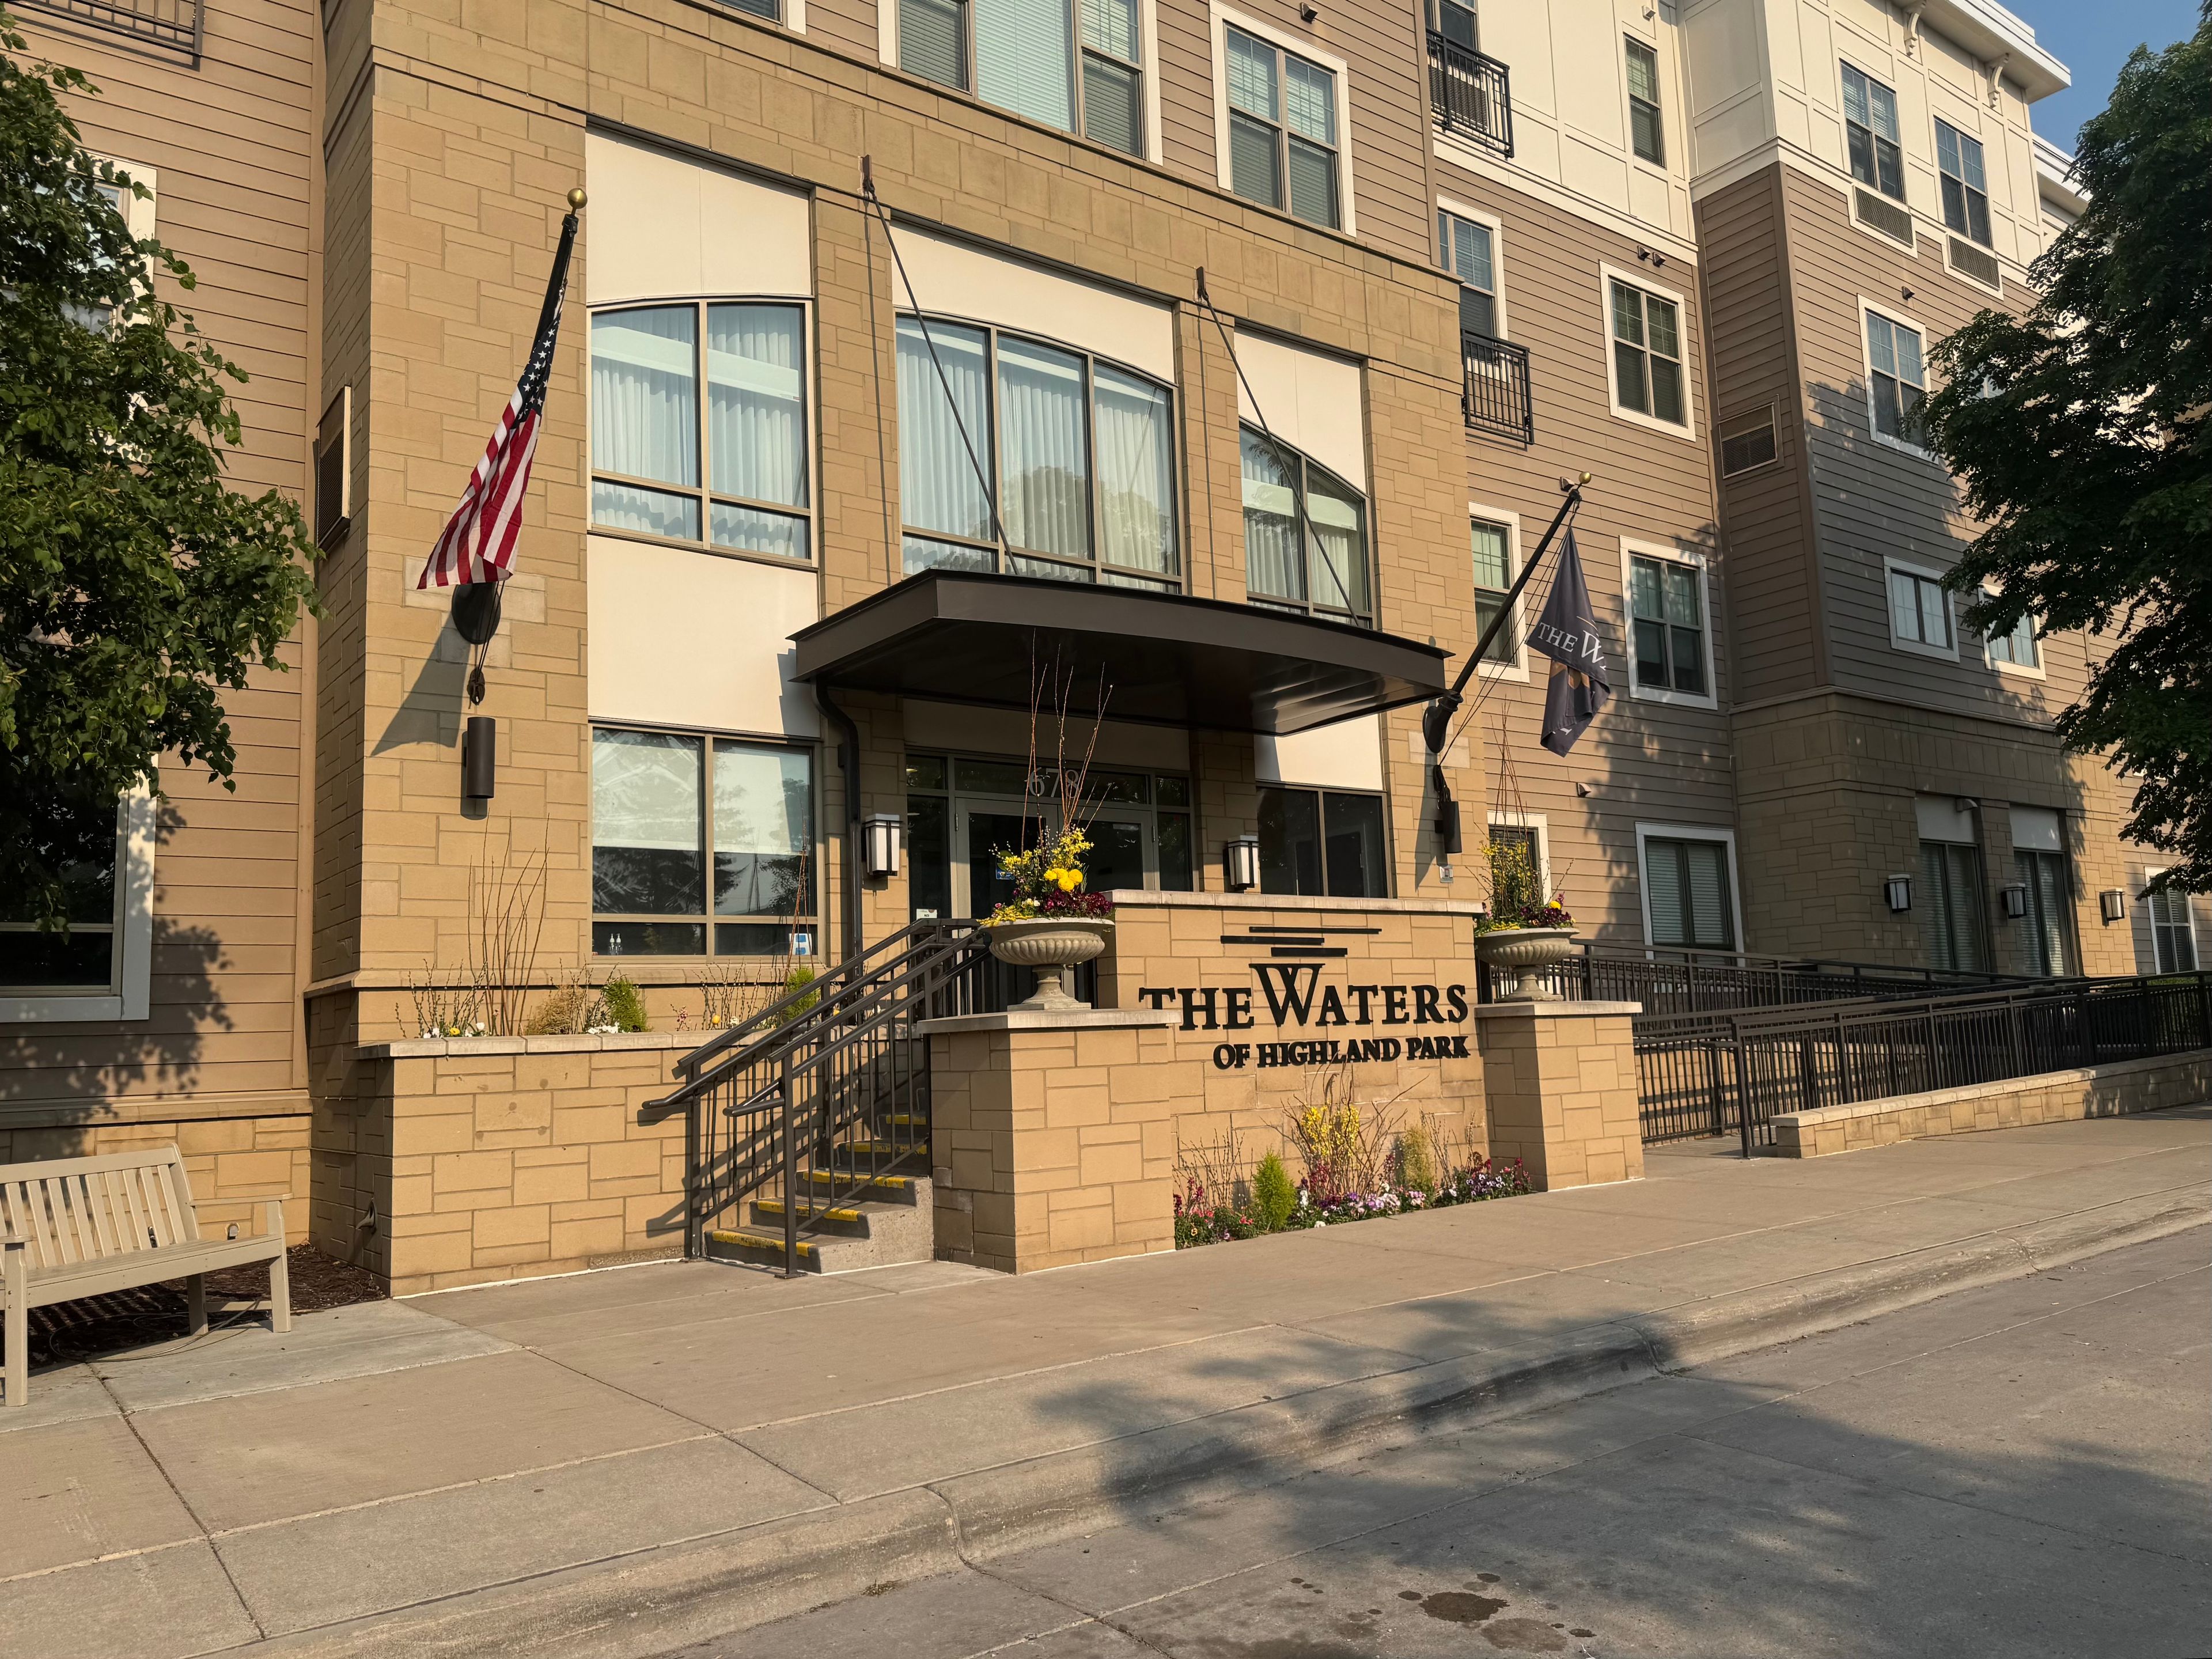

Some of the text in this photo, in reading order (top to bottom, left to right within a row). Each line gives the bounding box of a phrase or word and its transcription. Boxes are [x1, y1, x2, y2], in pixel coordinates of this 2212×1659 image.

[1538, 622, 1578, 653] THE
[1029, 767, 1080, 798] 678
[1138, 963, 1468, 1031] THE WATERS
[1213, 1036, 1471, 1070] OF HIGHLAND PARK
